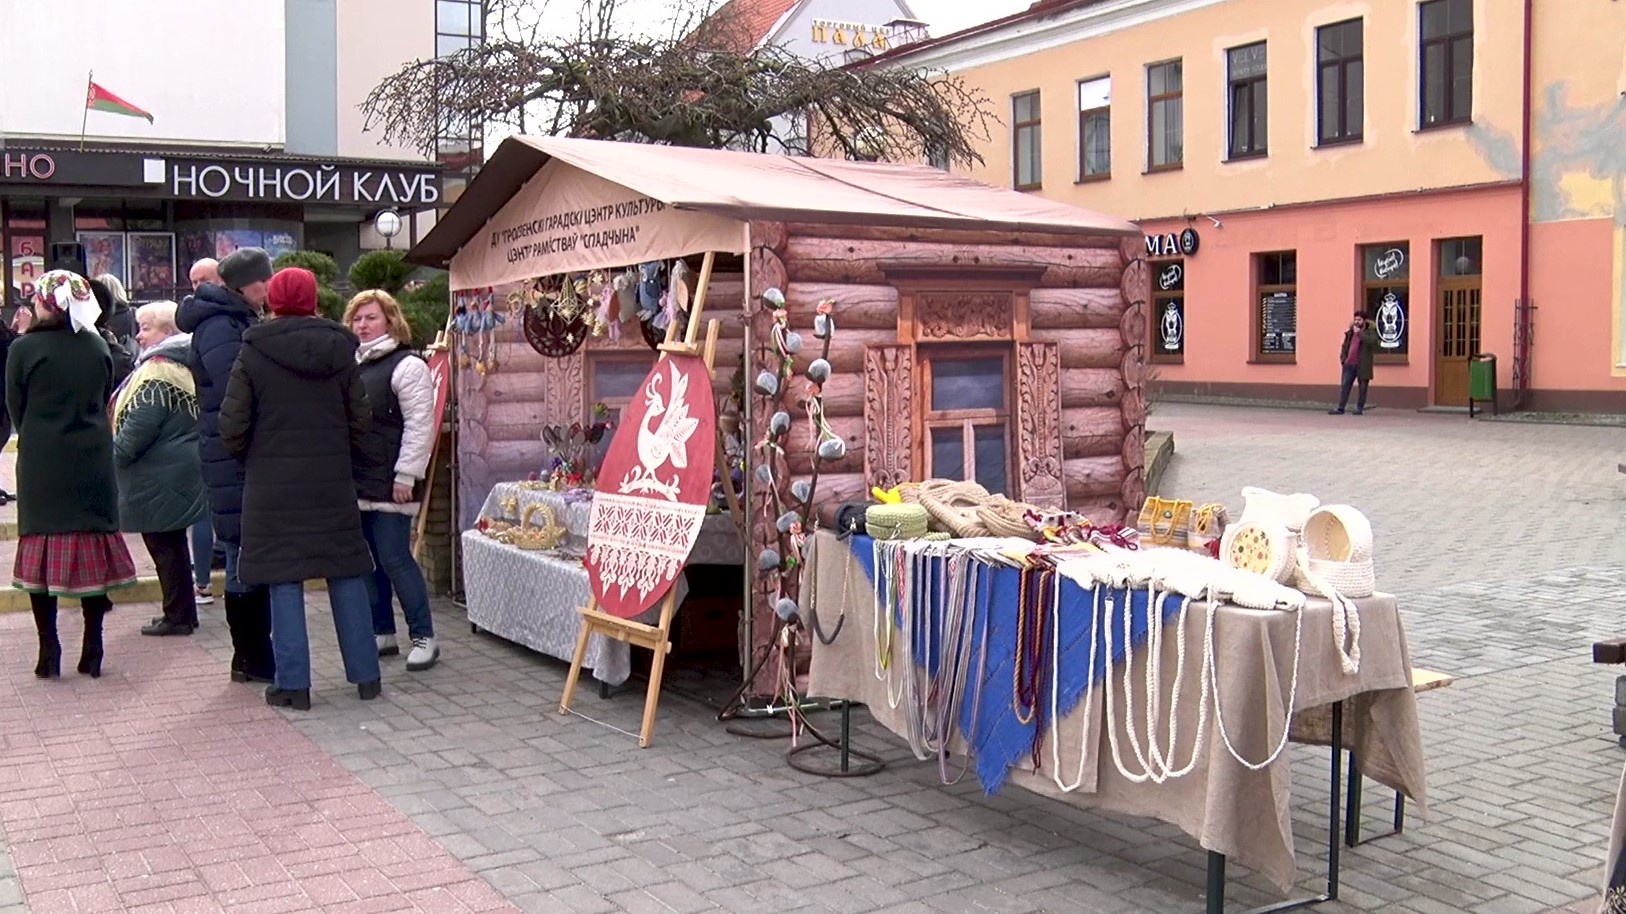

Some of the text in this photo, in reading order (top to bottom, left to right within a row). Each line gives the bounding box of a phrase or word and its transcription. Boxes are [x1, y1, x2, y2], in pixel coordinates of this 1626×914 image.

[5, 153, 55, 179] НО
[173, 165, 438, 203] НОЧНОЙ КЛУБ
[545, 210, 583, 231] ГАРАДСКІ
[584, 206, 614, 227] ЦЭНТР
[20, 241, 35, 298] БАР
